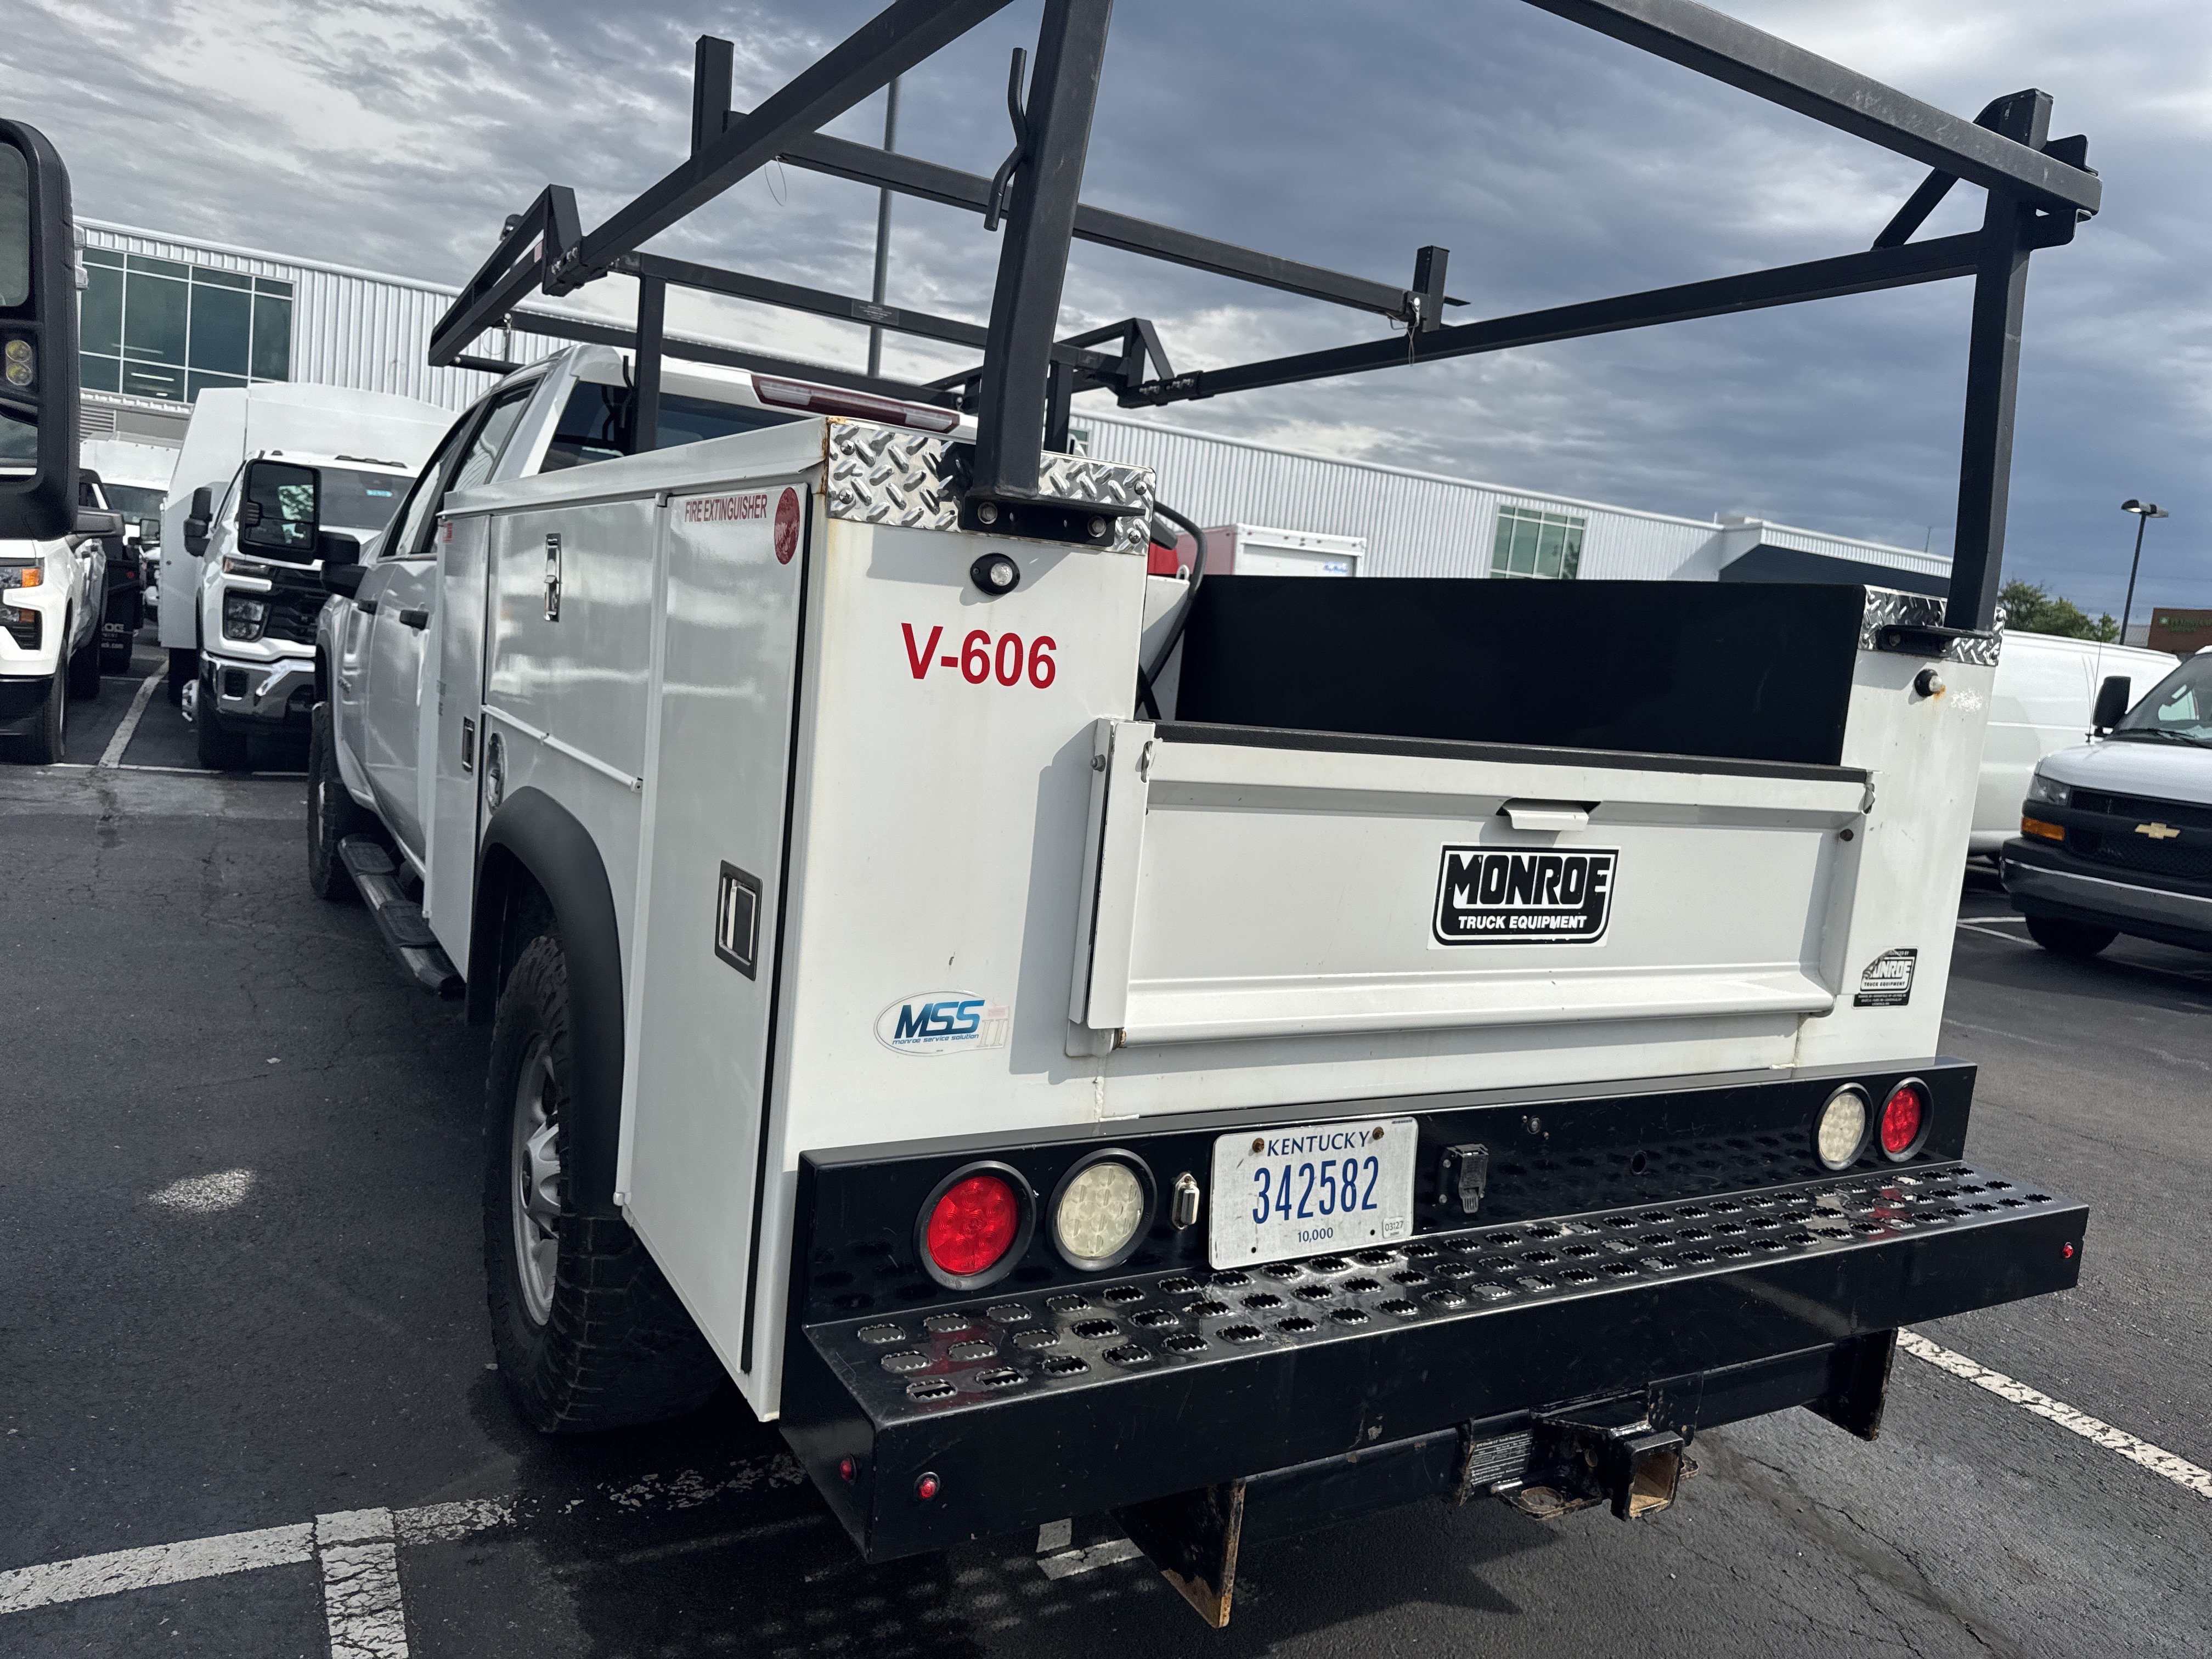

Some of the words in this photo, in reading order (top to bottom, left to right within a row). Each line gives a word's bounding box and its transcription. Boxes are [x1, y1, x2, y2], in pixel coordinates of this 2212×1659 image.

[685, 500, 702, 522] FIRE
[704, 494, 768, 521] EXTINGUISHER
[901, 623, 1057, 690] V-606
[1444, 854, 1611, 905] MONROE
[1458, 916, 1506, 929] TRUCK
[1509, 916, 1587, 929] EQUIPMENT
[894, 1000, 985, 1039] MSS
[1267, 1131, 1372, 1156] KENTUCKY
[1252, 1156, 1380, 1224] 342582
[1297, 1227, 1334, 1243] 10,000
